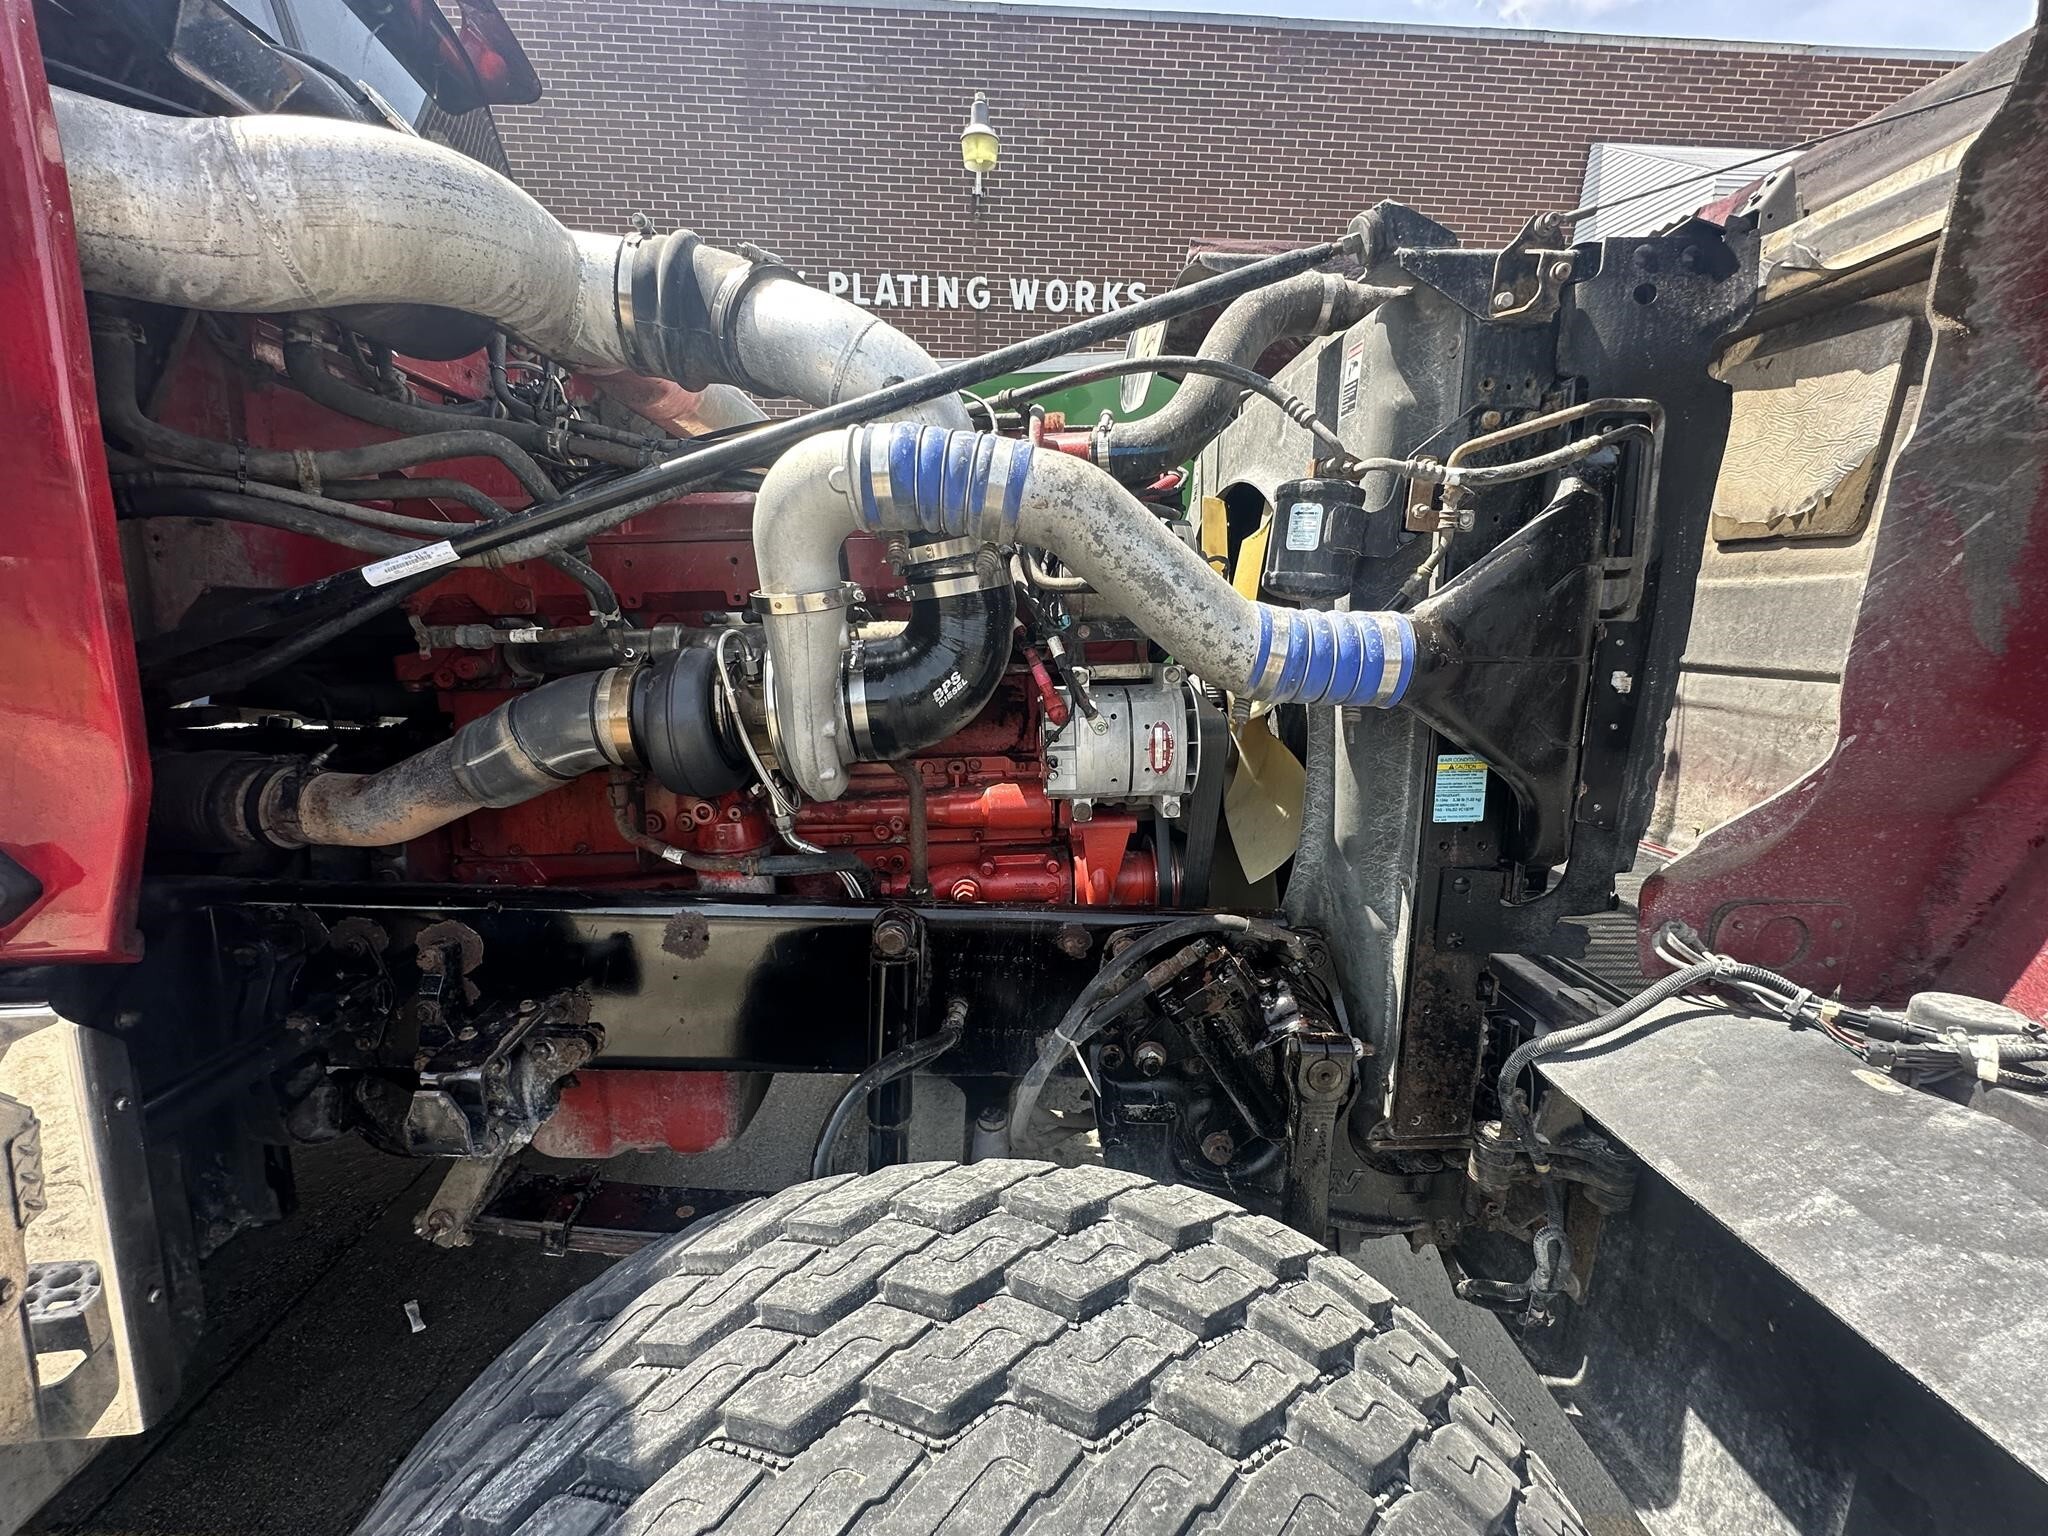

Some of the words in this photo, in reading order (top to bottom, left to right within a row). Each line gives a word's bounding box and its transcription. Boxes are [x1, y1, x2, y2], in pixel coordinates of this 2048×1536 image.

[828, 271, 991, 310] PLATING
[1010, 278, 1147, 313] WORKS
[933, 671, 961, 703] BPS
[938, 678, 968, 708] DIESEL
